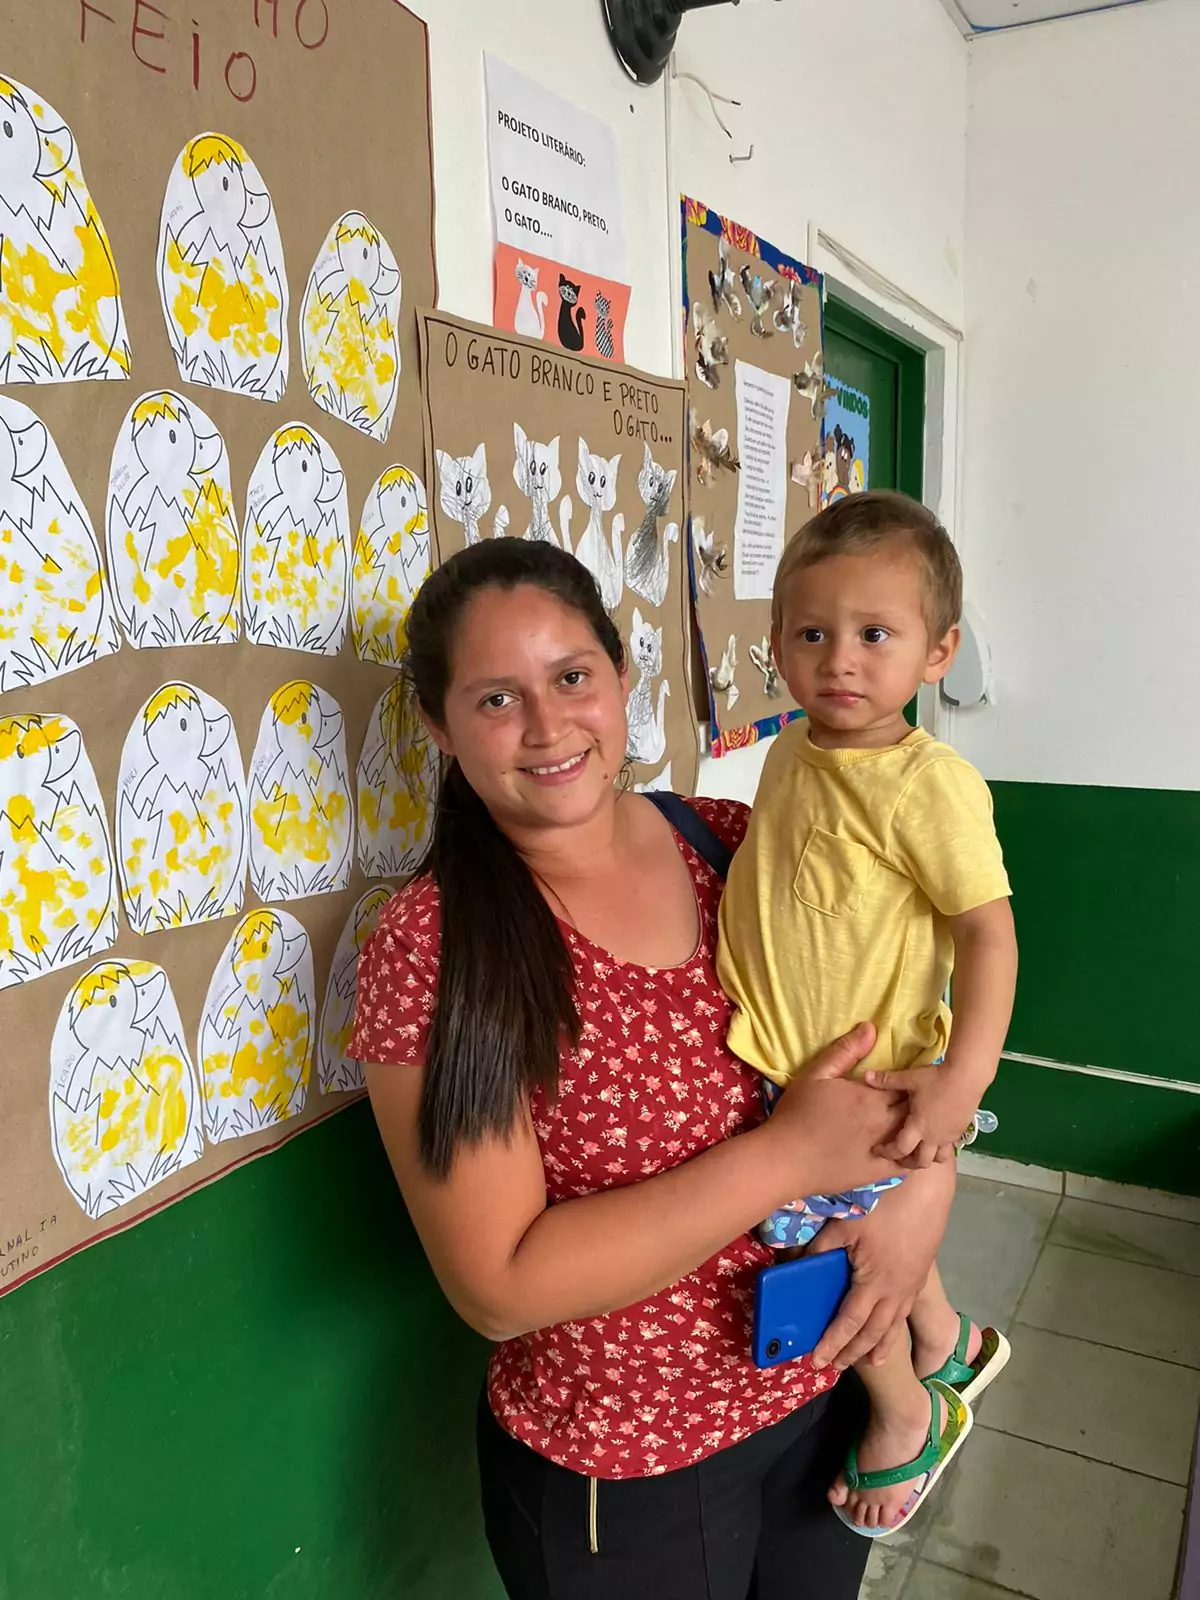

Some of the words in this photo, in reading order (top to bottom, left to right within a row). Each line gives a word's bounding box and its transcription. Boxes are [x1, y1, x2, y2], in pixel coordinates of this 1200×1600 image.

[498, 110, 539, 143] PROJETO
[541, 132, 586, 167] LITERÁRIO:
[502, 176, 509, 190] O
[511, 181, 540, 202] GATO
[542, 191, 582, 222] BRANCO,
[583, 209, 609, 234] PRETO,
[504, 208, 512, 222] O
[445, 332, 458, 367] O
[467, 339, 520, 379] GATO
[531, 355, 594, 395] BRANCO
[603, 381, 612, 402] E
[619, 382, 659, 414] PRETO
[613, 409, 623, 435] O
[626, 414, 672, 443] GATO...
